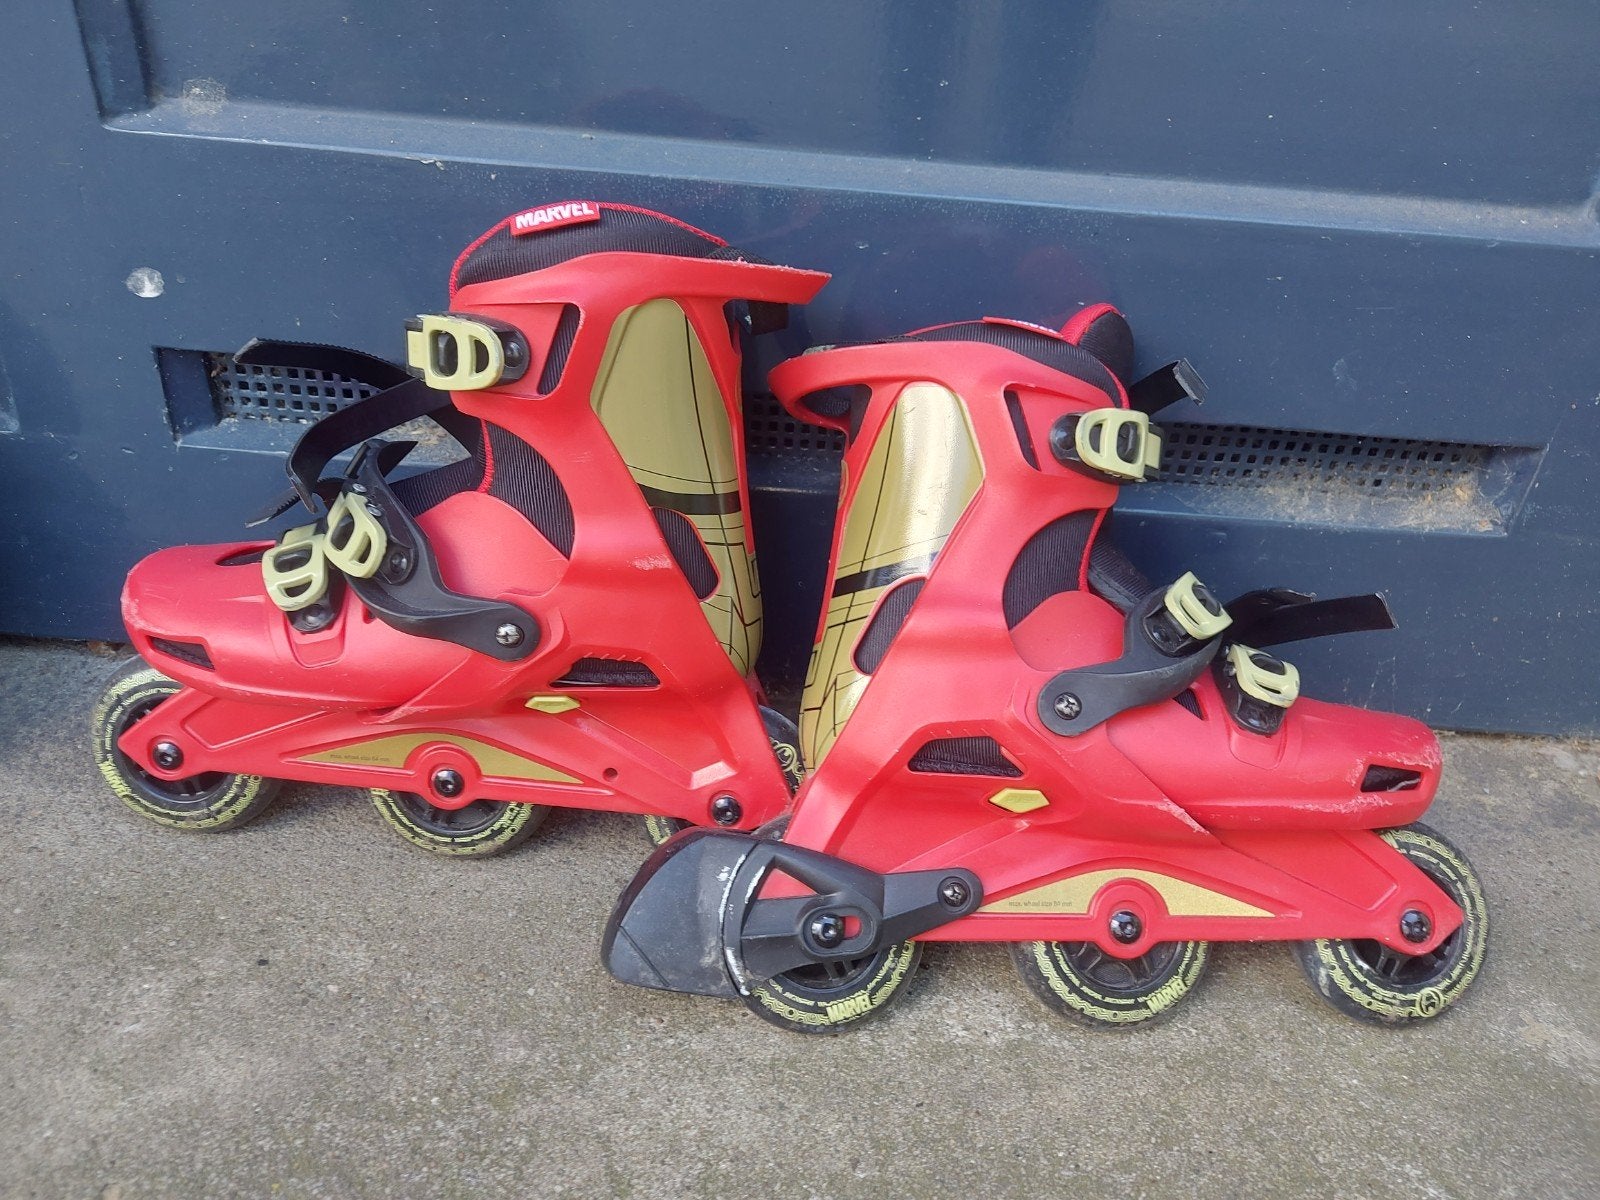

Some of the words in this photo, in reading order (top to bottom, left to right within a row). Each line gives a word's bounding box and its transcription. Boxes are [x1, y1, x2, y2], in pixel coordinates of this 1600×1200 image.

[515, 203, 594, 229] MARVEL
[826, 994, 871, 1023] MARVEL
[1147, 979, 1188, 1014] MARVEL
